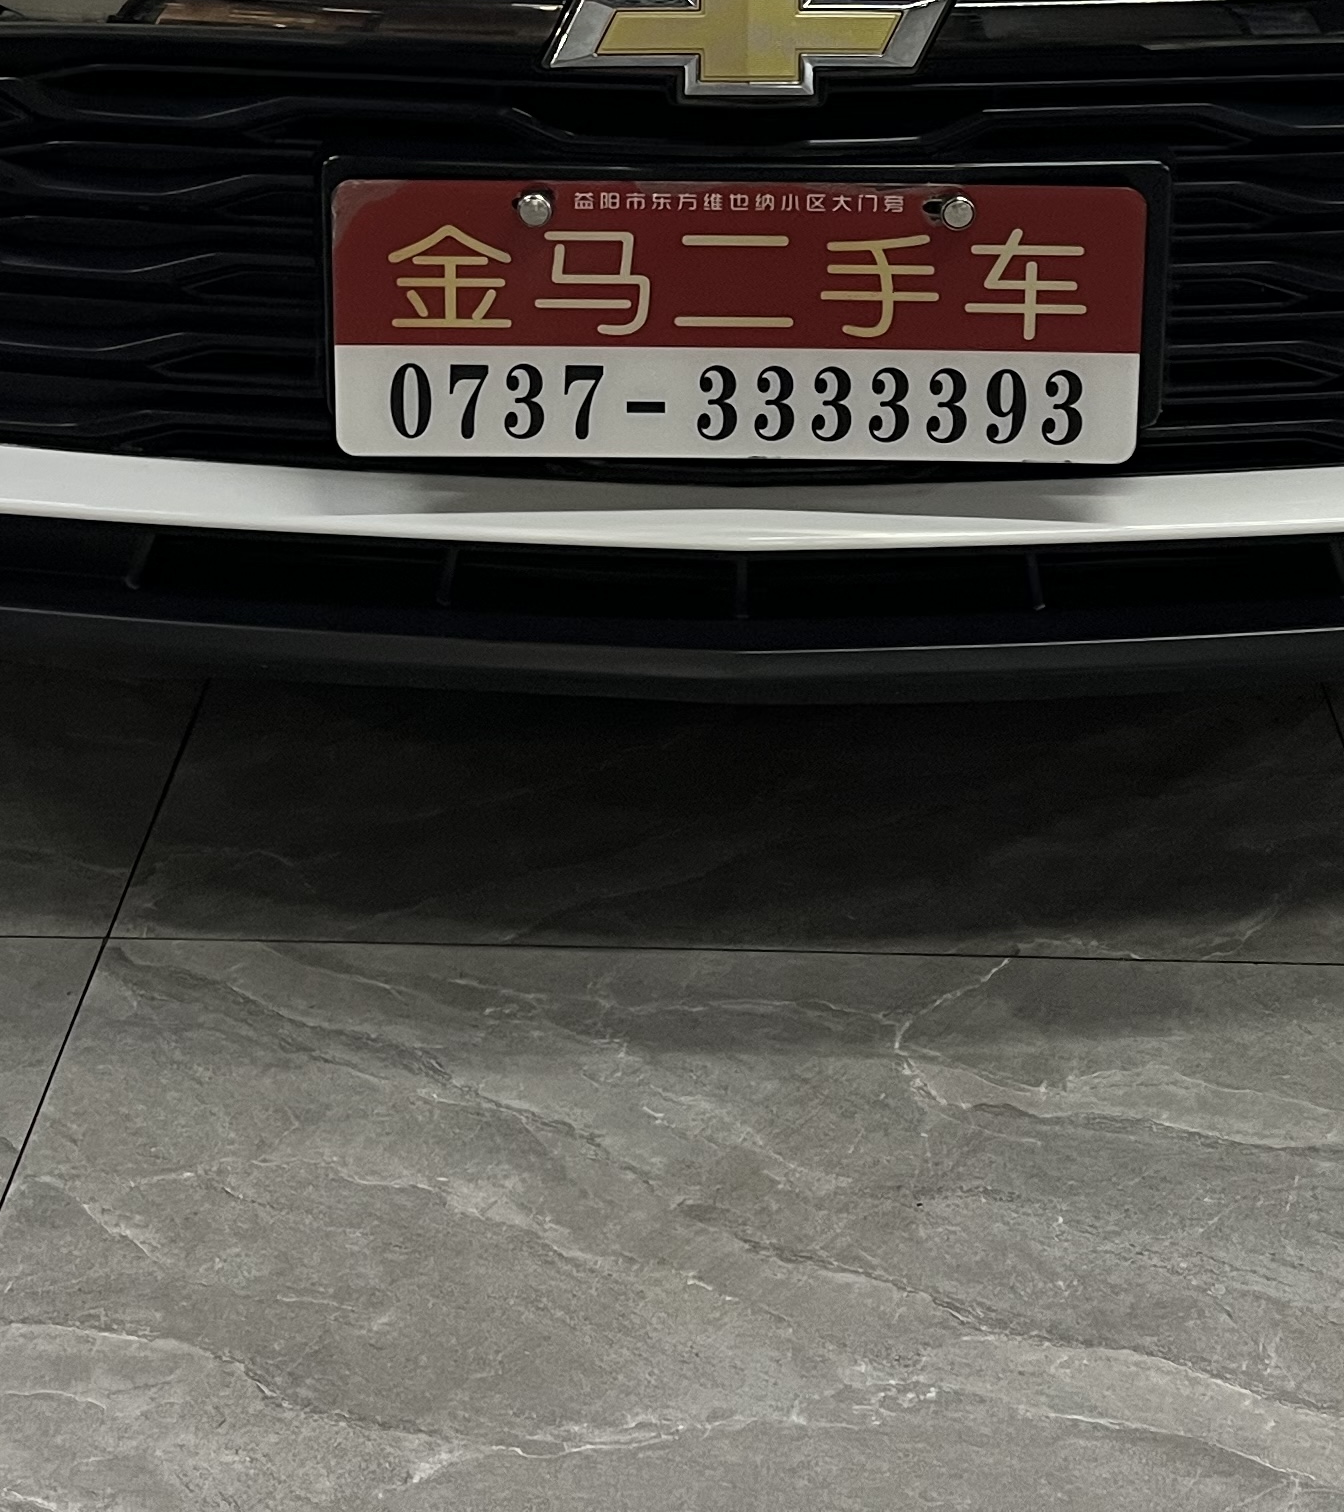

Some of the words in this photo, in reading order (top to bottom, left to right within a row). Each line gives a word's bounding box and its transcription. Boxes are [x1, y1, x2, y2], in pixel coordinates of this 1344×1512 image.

[387, 223, 1088, 341] 金马二手车
[388, 361, 1086, 446] 0737-3333393
